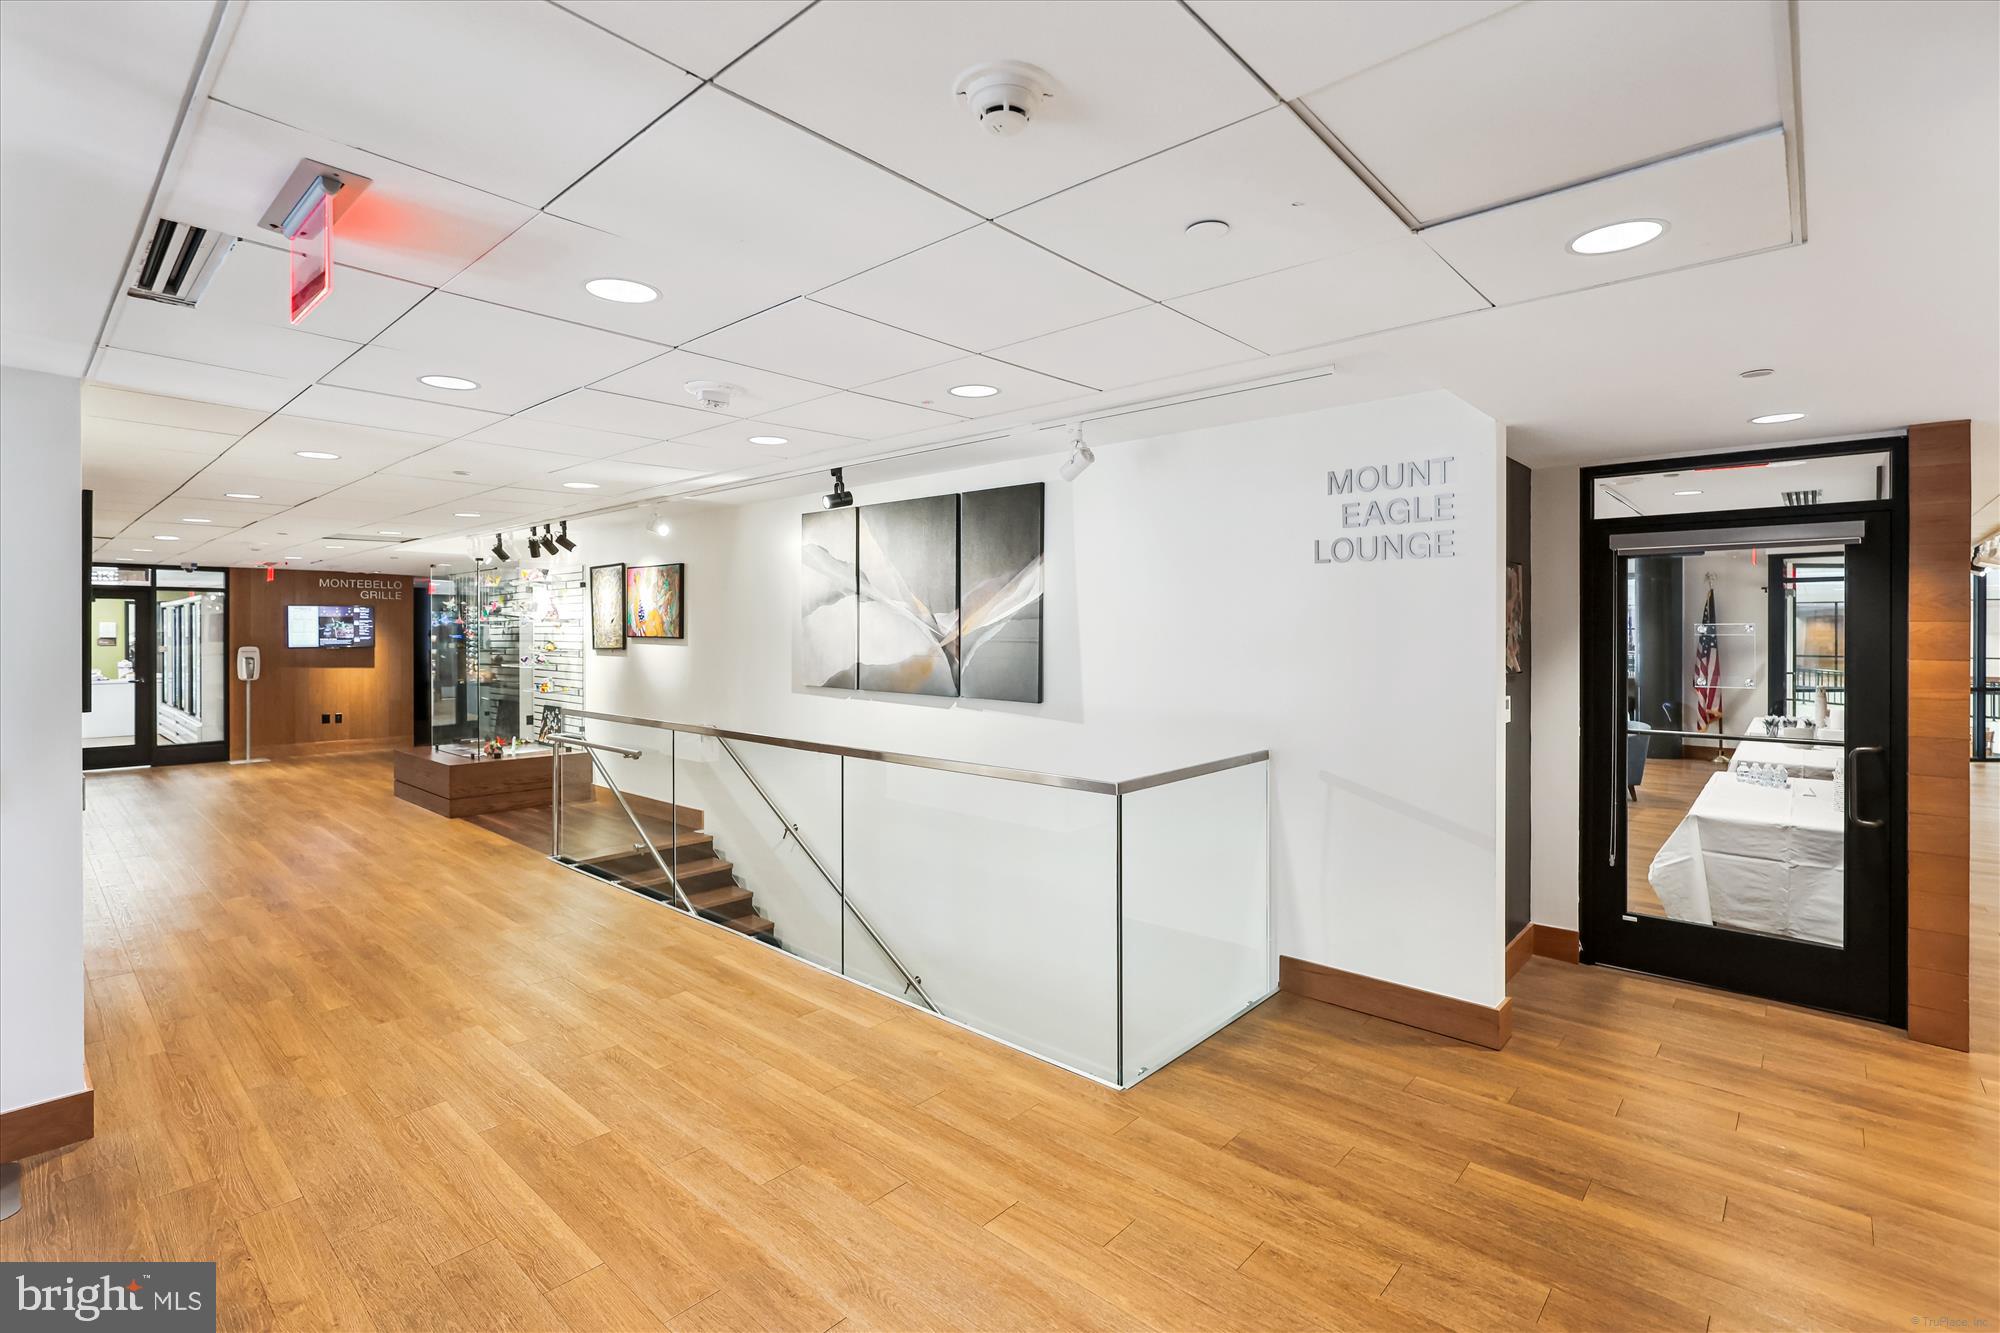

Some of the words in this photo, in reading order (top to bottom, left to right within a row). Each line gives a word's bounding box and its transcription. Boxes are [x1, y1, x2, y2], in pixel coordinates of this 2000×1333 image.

[1327, 456, 1455, 495] MOUNT
[1342, 493, 1455, 528] EAGLE
[1314, 530, 1455, 564] LOUNGE
[319, 578, 402, 589] MONTEBELLO
[360, 590, 402, 600] GRILLE
